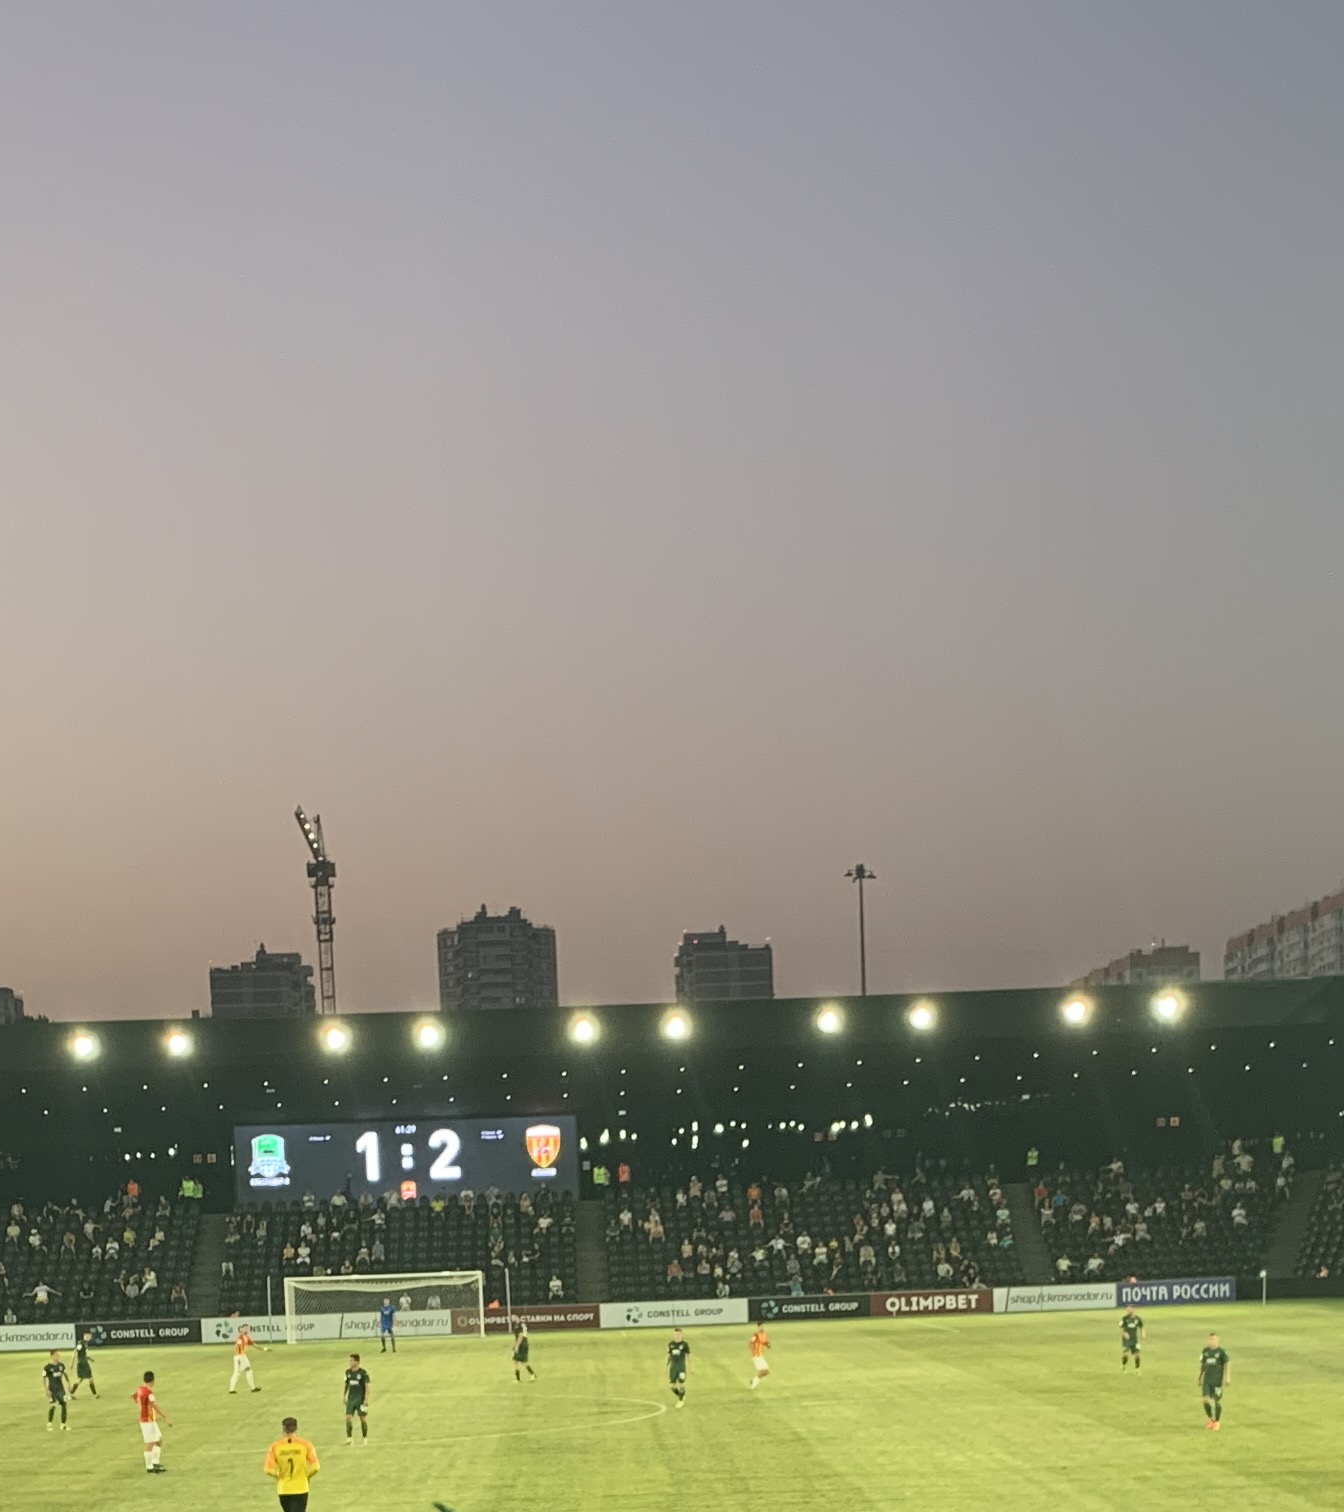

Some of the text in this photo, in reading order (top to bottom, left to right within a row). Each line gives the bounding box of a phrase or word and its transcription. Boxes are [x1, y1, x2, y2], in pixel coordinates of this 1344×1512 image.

[356, 1130, 381, 1182] 1
[428, 1128, 462, 1180] 2
[1122, 1282, 1230, 1302] ПОЧТА РОССИИ
[782, 1302, 859, 1313] CONSTELL GROUP
[885, 1294, 979, 1312] OLIMPBET
[647, 1307, 724, 1318] CONSTELL GROUP
[469, 1317, 510, 1325] OLMPBET
[110, 1327, 190, 1339] CONSTELL GROUP
[238, 1325, 281, 1333] CNSTELL
